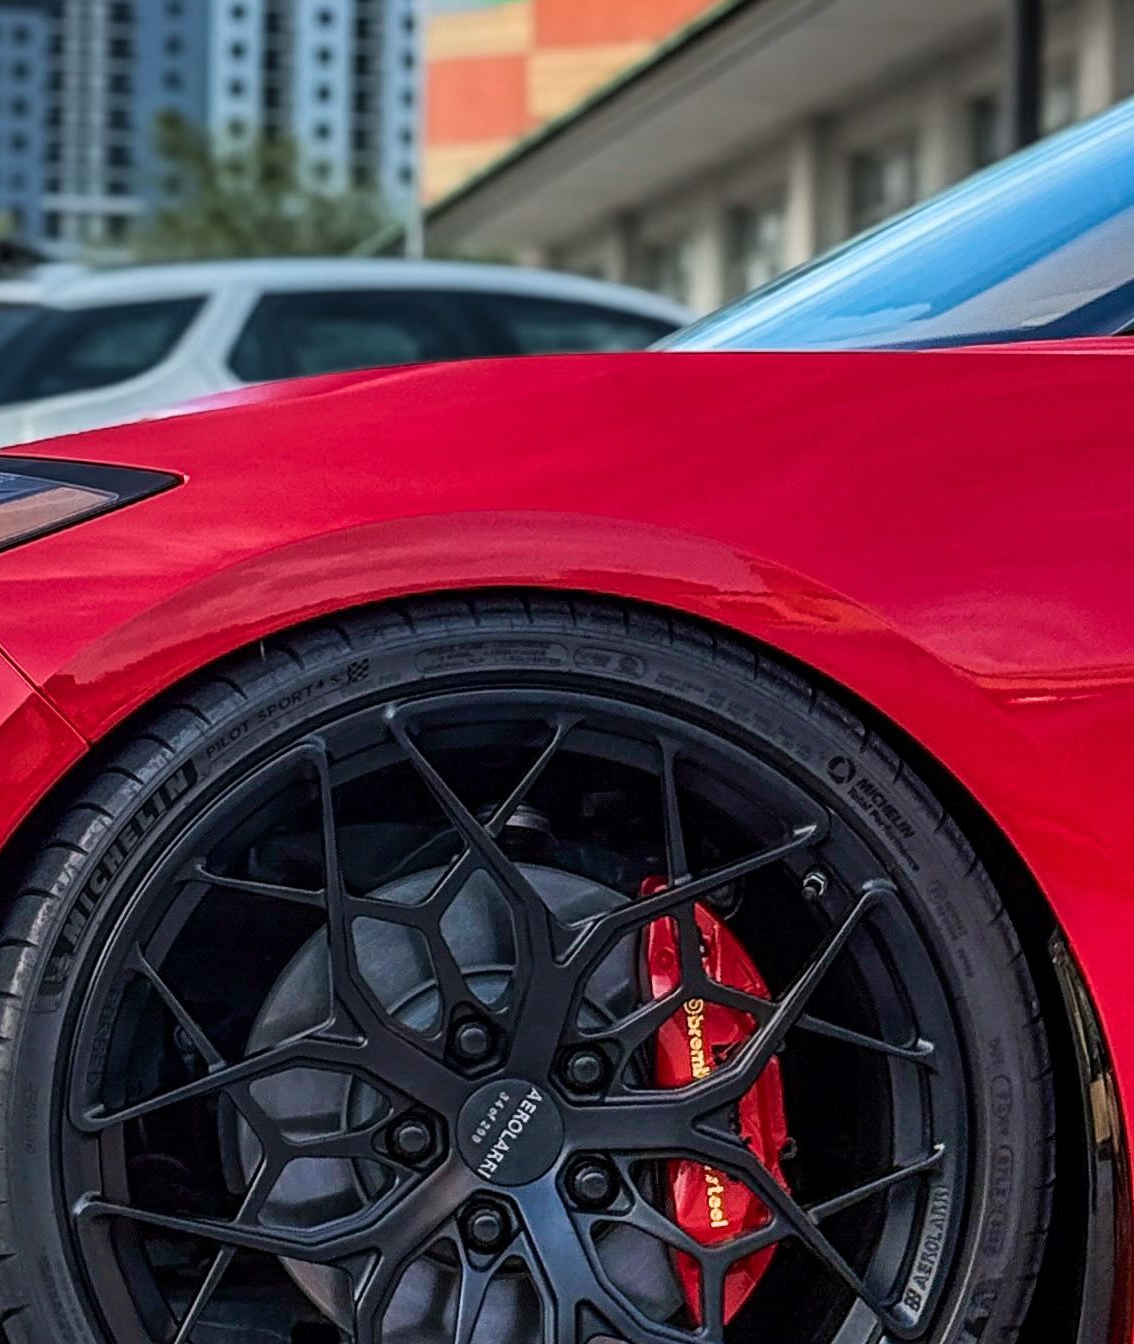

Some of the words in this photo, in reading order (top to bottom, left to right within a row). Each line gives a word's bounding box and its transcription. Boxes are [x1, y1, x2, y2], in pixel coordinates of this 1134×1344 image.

[202, 717, 254, 760] PILOT
[253, 682, 317, 724] SPORT
[855, 773, 916, 842] MICHELIN
[61, 767, 191, 945] MICHELIN
[687, 1014, 711, 1078] bremb
[471, 1120, 491, 1144] 200
[477, 1087, 543, 1178] AEROLARRI
[487, 1107, 498, 1122] of
[494, 1091, 510, 1109] 34
[704, 1164, 729, 1227] steel
[913, 1184, 951, 1291] AEROLARRI
